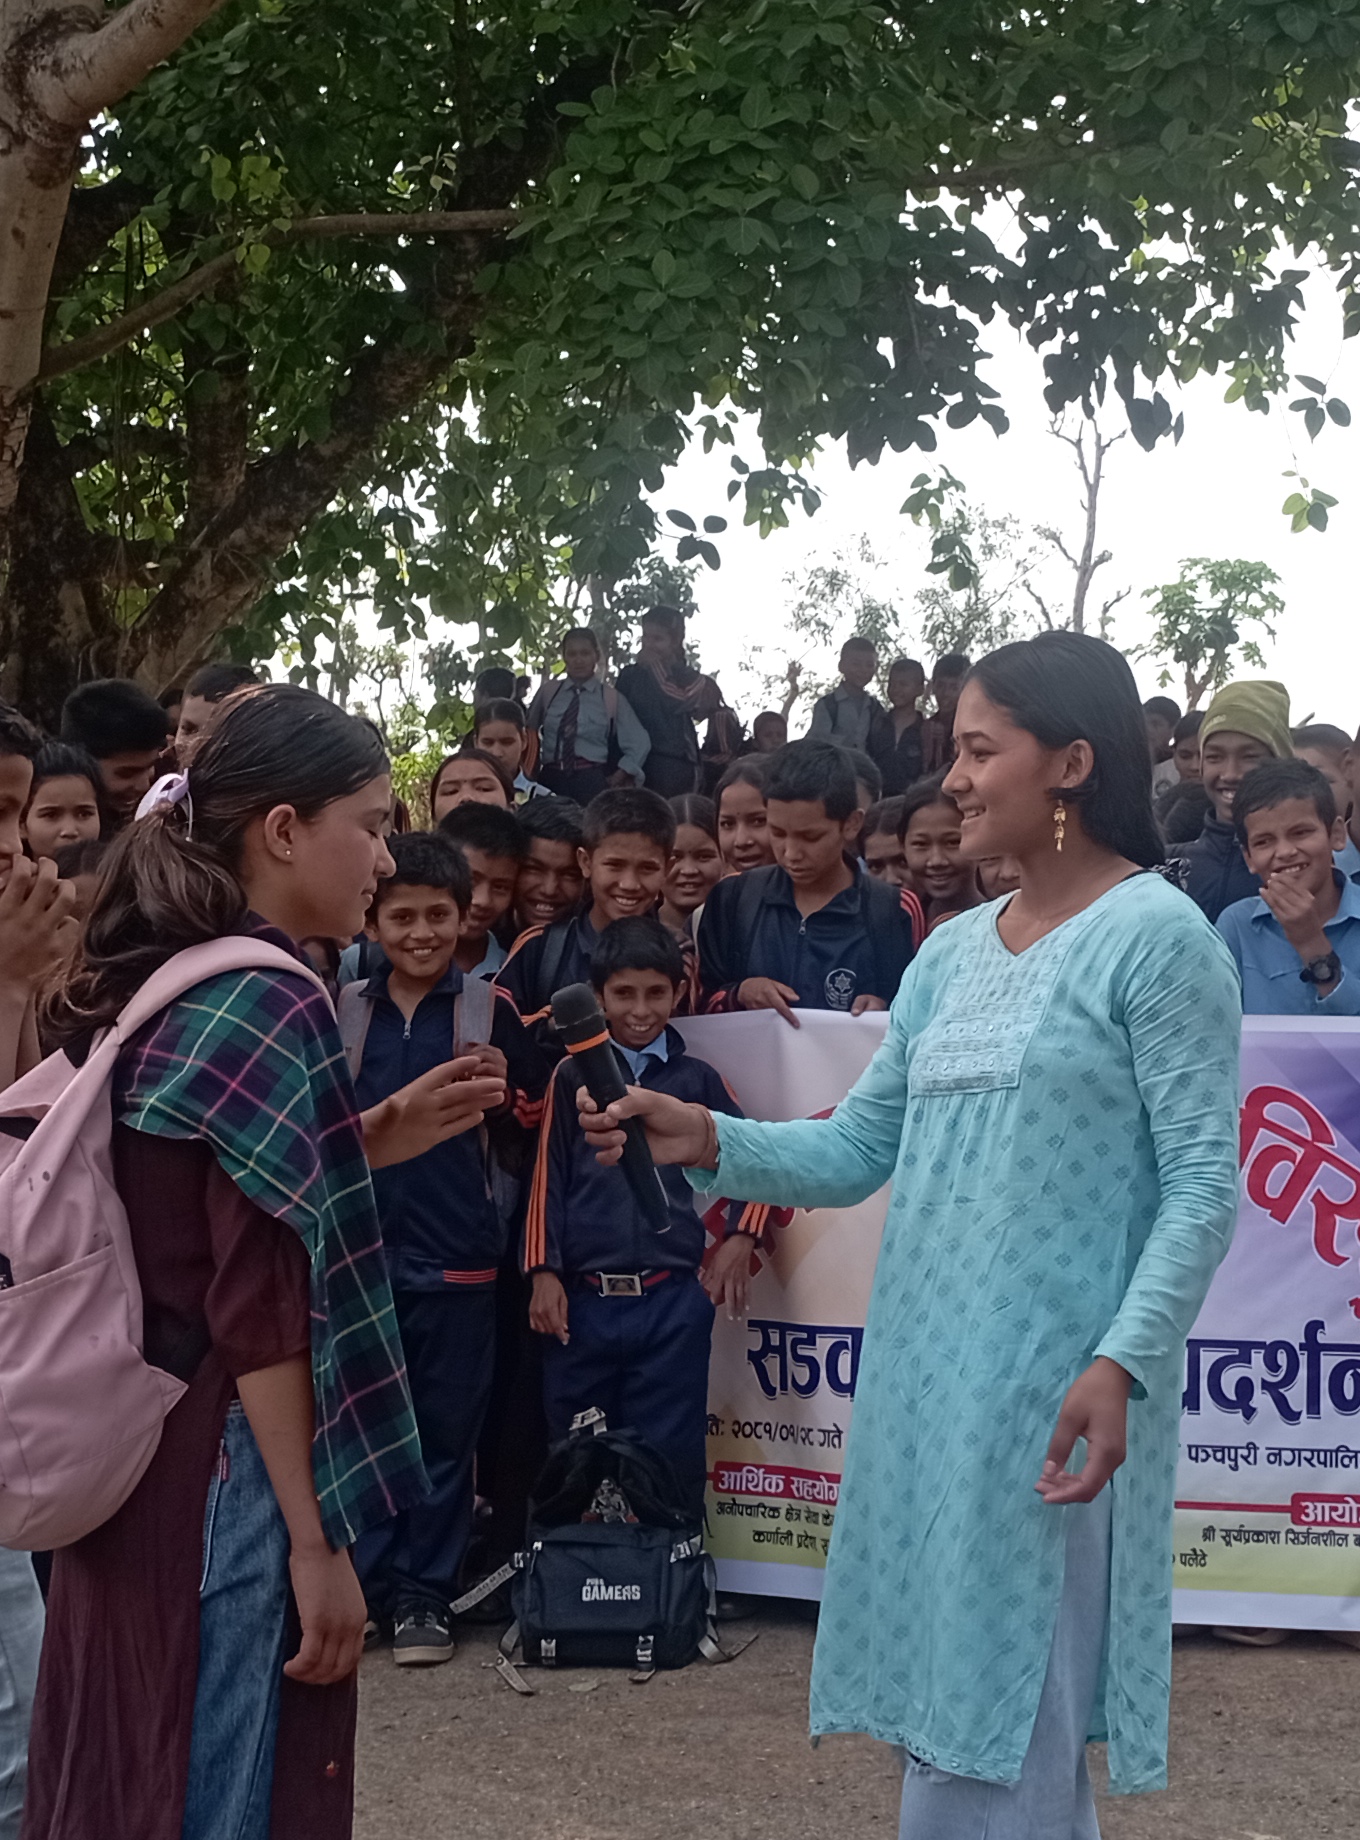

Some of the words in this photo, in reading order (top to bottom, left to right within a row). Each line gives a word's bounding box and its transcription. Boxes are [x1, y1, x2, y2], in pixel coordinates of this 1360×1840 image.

[818, 1423, 844, 1449] गते
[1187, 1442, 1259, 1471] पञ्चपुरी
[718, 1466, 785, 1493] आर्थिक
[752, 1527, 793, 1547] कर्णाली
[1202, 1525, 1215, 1542] श्री
[582, 1585, 641, 1602] GAMERS
